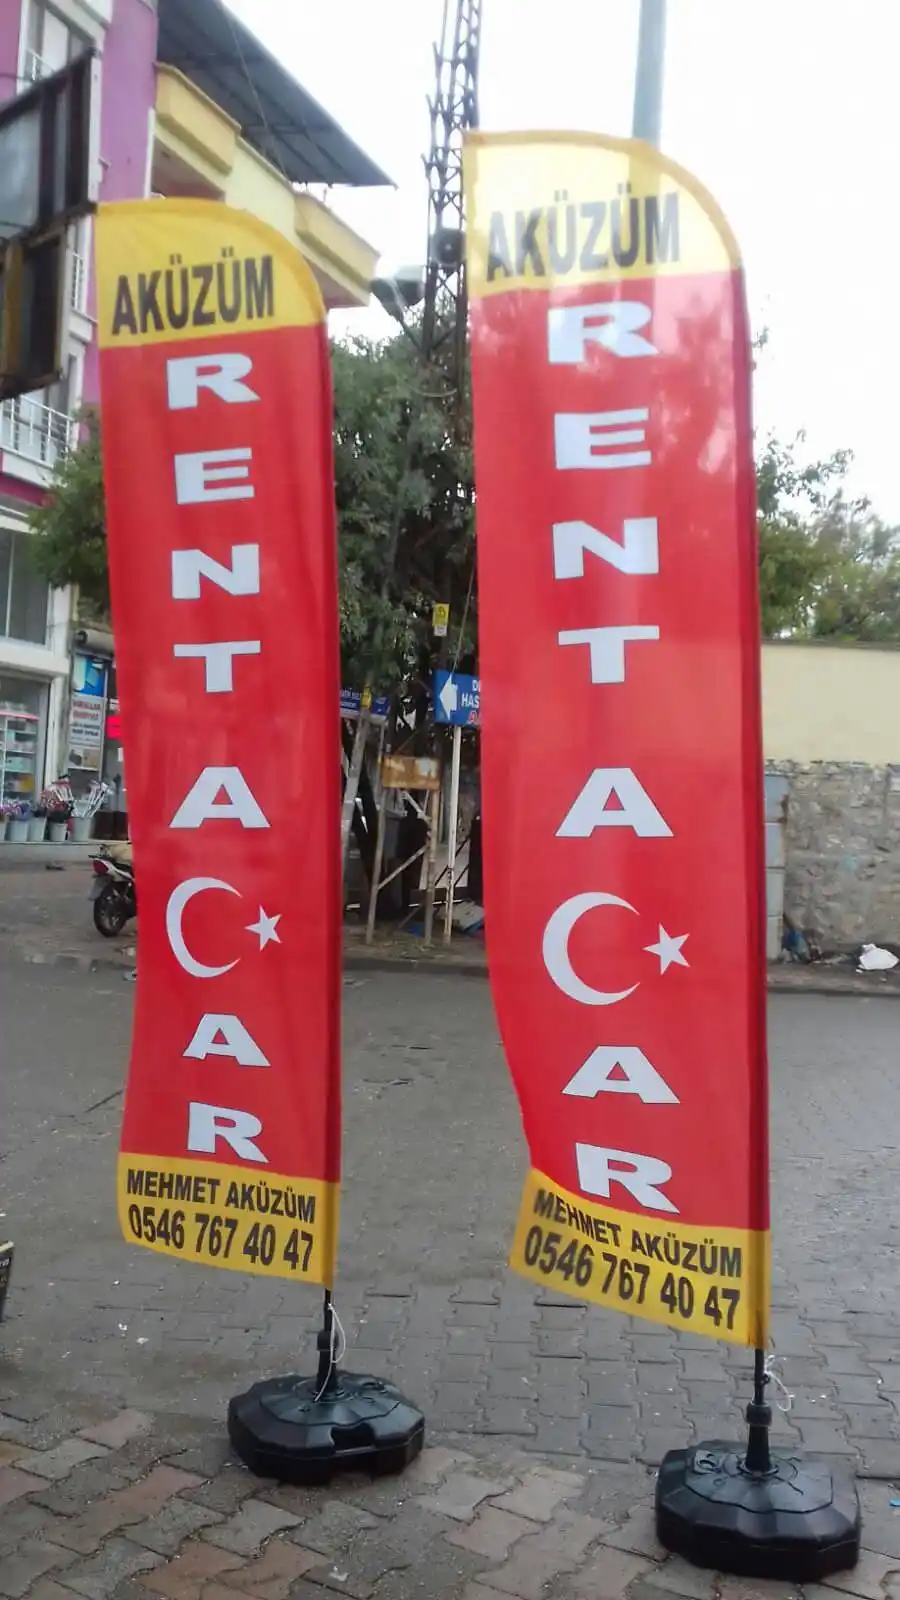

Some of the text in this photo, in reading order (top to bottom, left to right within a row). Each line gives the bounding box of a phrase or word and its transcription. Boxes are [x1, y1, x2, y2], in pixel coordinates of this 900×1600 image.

[486, 183, 681, 283] AKÜZÜM
[111, 246, 274, 336] AKÜZÜM
[127, 1169, 316, 1224] MEHMET AKÜZÜM
[128, 1204, 314, 1272] 0546 767 40 47
[534, 1189, 742, 1278] MEHMET AKÜZÜM
[524, 1225, 741, 1331] 0546 767 40 47
